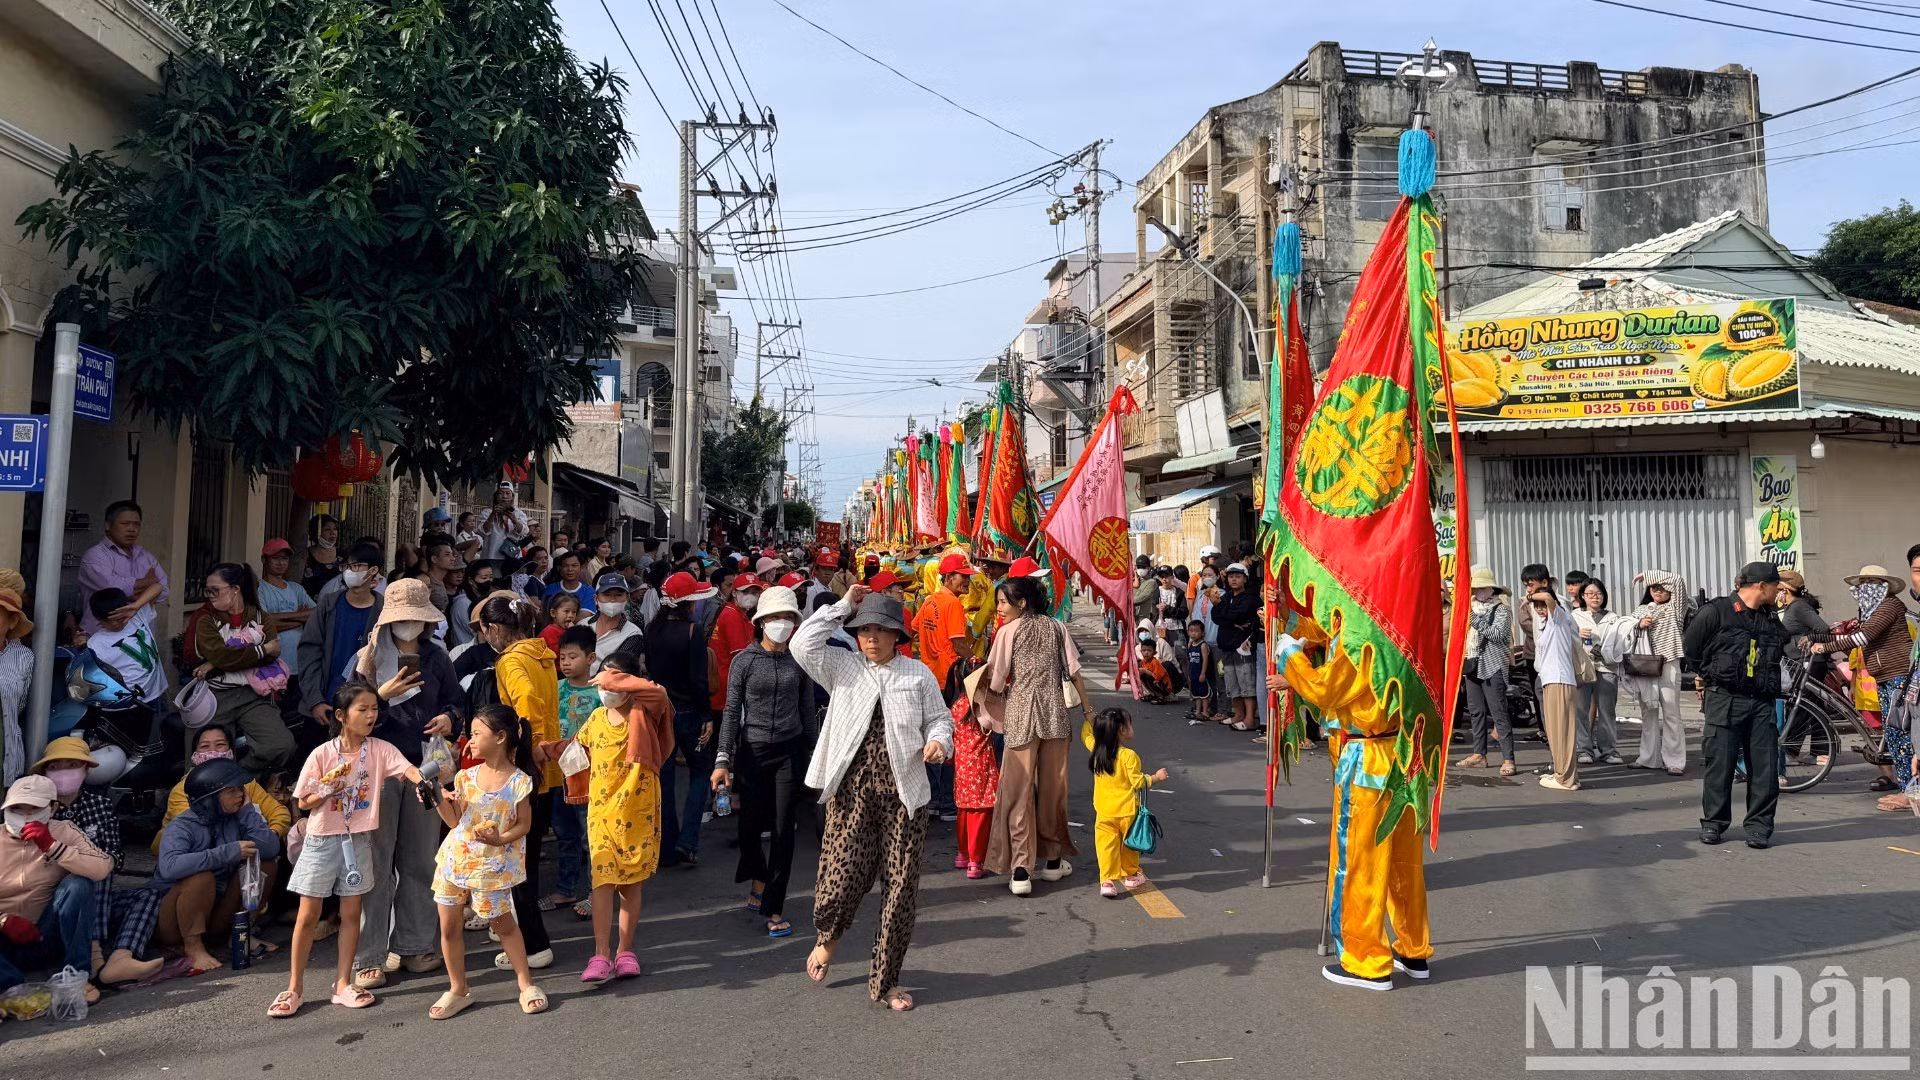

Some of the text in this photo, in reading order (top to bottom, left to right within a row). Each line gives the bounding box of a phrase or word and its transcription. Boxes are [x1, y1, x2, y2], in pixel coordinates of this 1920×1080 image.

[1460, 310, 1720, 352] Hồng Nhung Durian
[1738, 329, 1766, 339] 100%
[1619, 339, 1649, 352] Ngọt
[1555, 355, 1641, 369] CHI NHÁNH 03
[1526, 373, 1565, 382] Chuyên
[1568, 371, 1588, 379] Các
[1592, 369, 1614, 380] Loại
[1642, 368, 1674, 377] Riêng
[76, 370, 109, 398] TRẦN PHÚ
[1601, 391, 1624, 399] Lượng
[1583, 402, 1622, 415] 0325
[1627, 401, 1656, 413] 766
[1662, 400, 1689, 411] 606
[7, 473, 12, 481] 5
[1759, 472, 1791, 502] Bao
[1439, 485, 1455, 512] go
[1761, 504, 1792, 546] Ăn
[1434, 521, 1456, 545] Sạc
